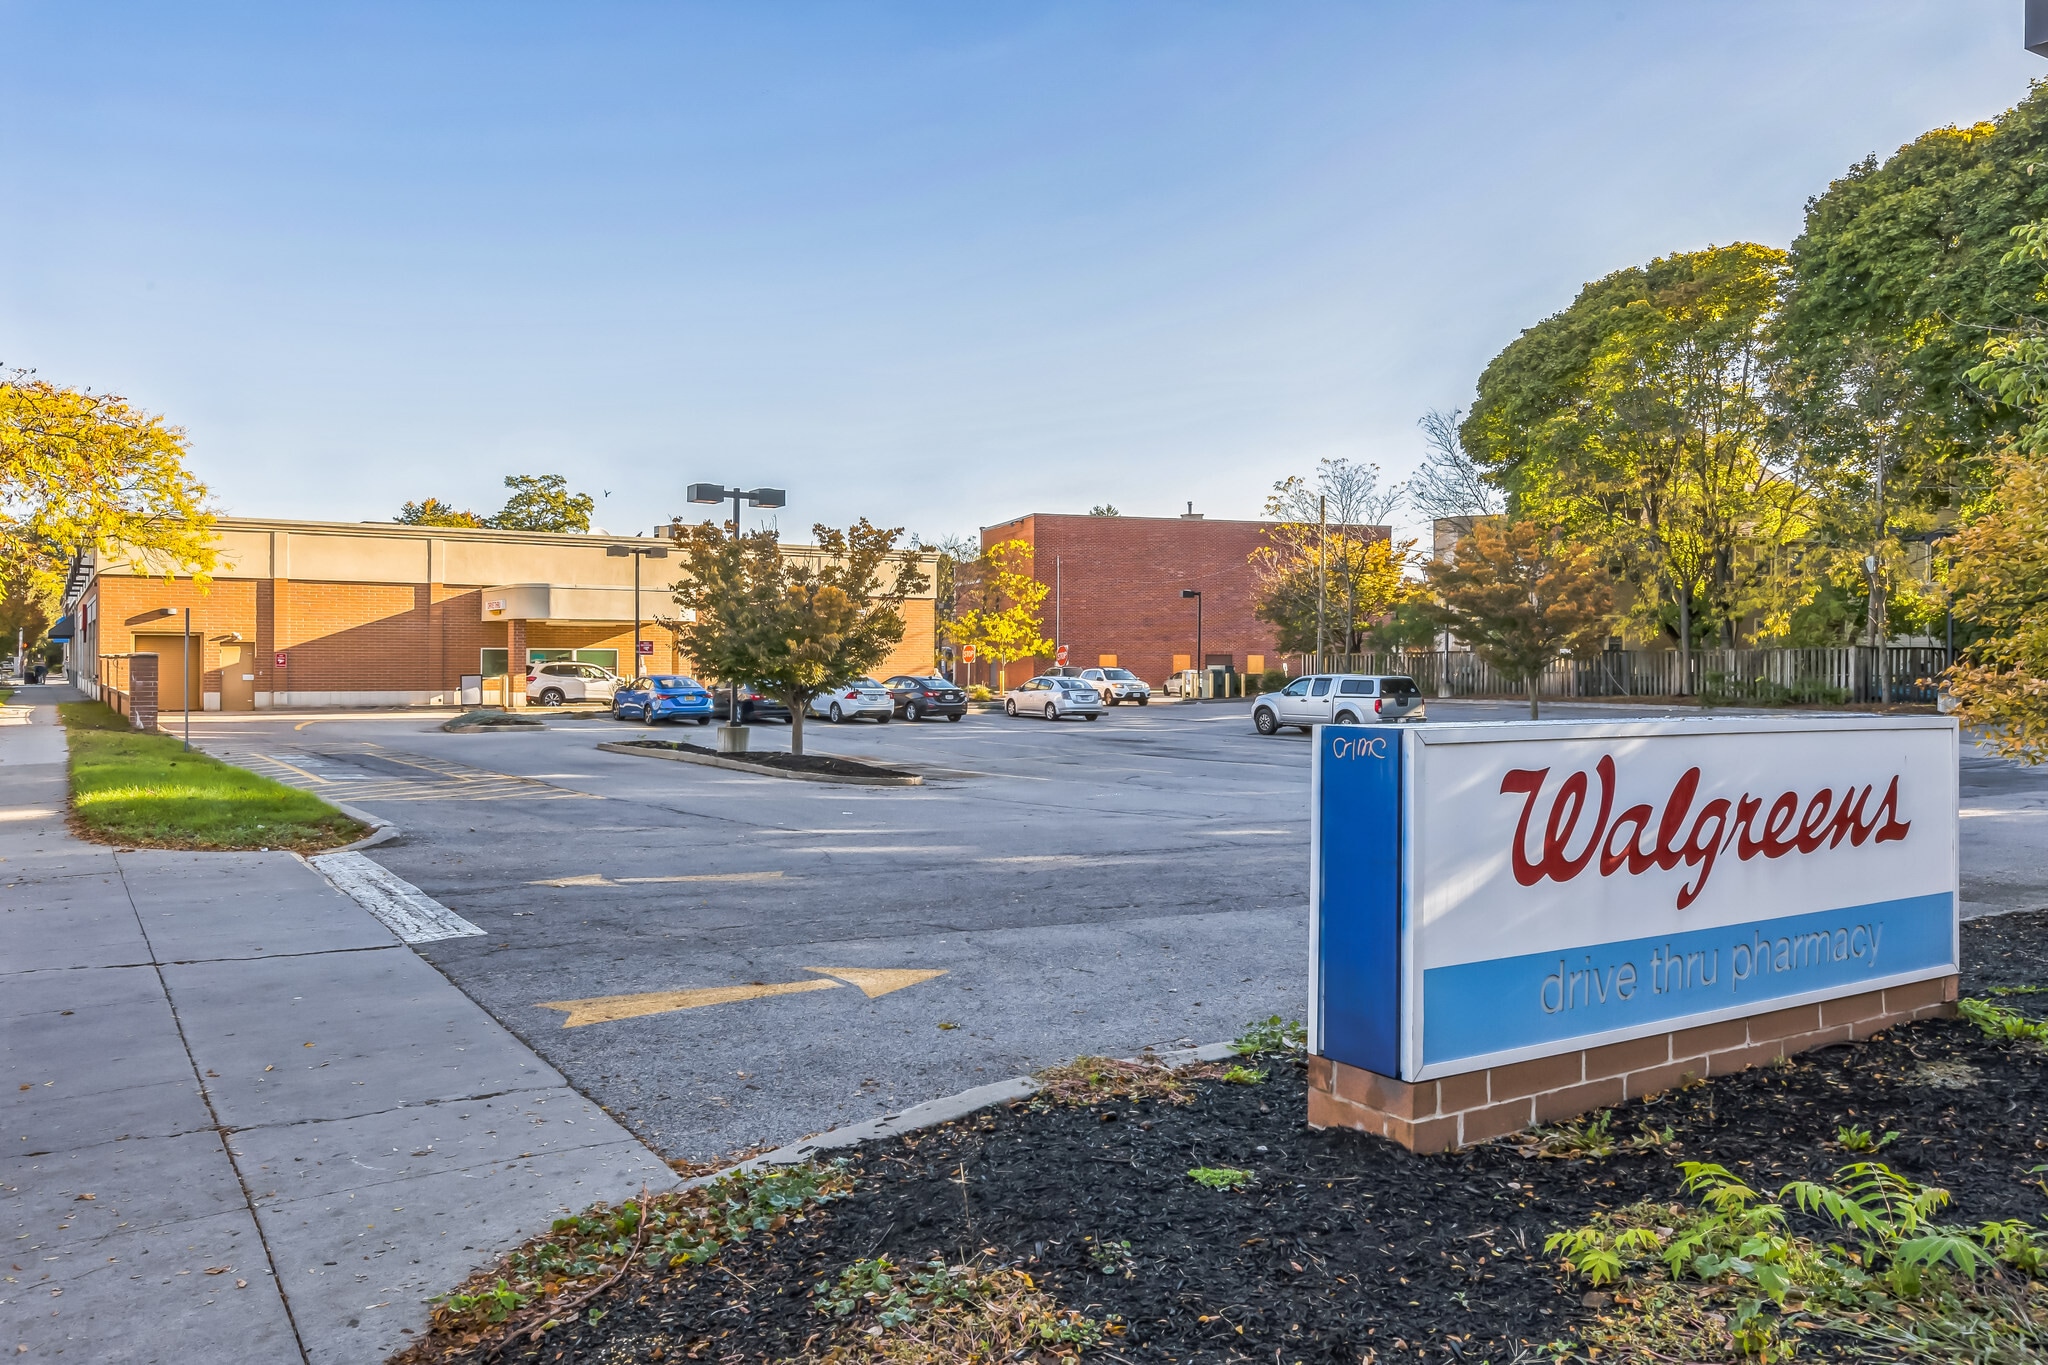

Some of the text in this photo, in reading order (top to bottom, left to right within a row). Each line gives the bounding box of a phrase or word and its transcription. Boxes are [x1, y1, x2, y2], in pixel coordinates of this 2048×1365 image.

[1500, 754, 1911, 910] Walgreens
[1540, 922, 1883, 1014] drive thru pharmacy
